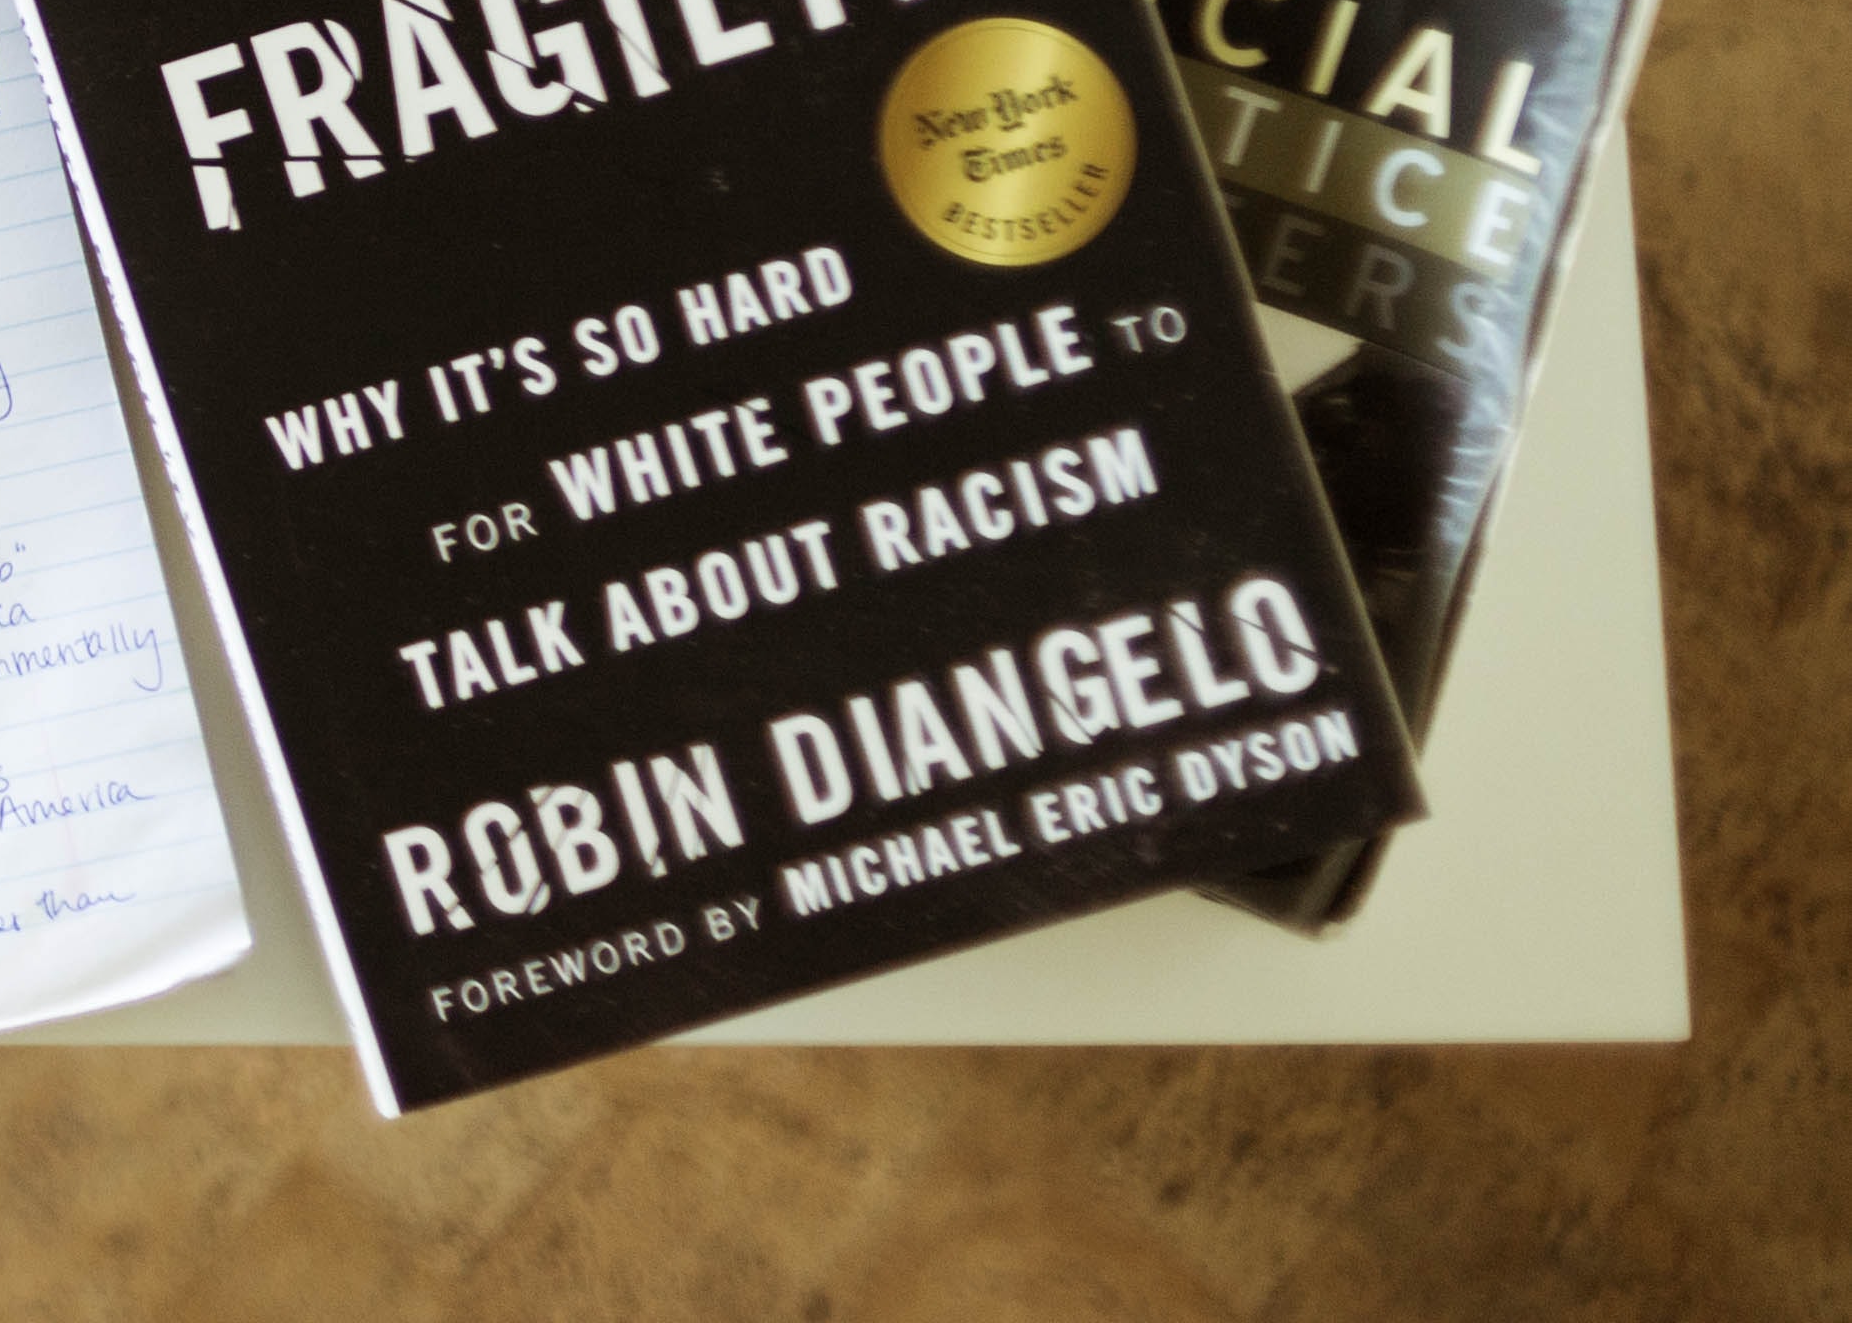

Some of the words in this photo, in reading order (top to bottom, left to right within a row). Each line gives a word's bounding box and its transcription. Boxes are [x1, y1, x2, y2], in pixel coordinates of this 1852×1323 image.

[913, 108, 989, 150] New
[988, 76, 1078, 131] York
[943, 163, 1110, 242] BESTSELLER
[961, 136, 1068, 183] Times
[265, 376, 408, 474] WHY
[581, 302, 664, 382] SO
[681, 244, 857, 347] HARD
[430, 500, 539, 565] FOR
[547, 394, 790, 524] WHITE
[803, 304, 1095, 449] PEOPLE
[1111, 303, 1189, 355] TO
[398, 601, 587, 712] TALK
[605, 520, 843, 652] ABOUT
[861, 427, 1161, 575] RACISM
[383, 743, 746, 938] ROBIN
[771, 575, 1329, 828] DIANGELO
[430, 919, 689, 1024] FOREWORD
[702, 896, 764, 946] BY
[780, 807, 1023, 921] MICHAEL
[1034, 769, 1165, 843] ERIC
[1184, 709, 1362, 804] DYSON
